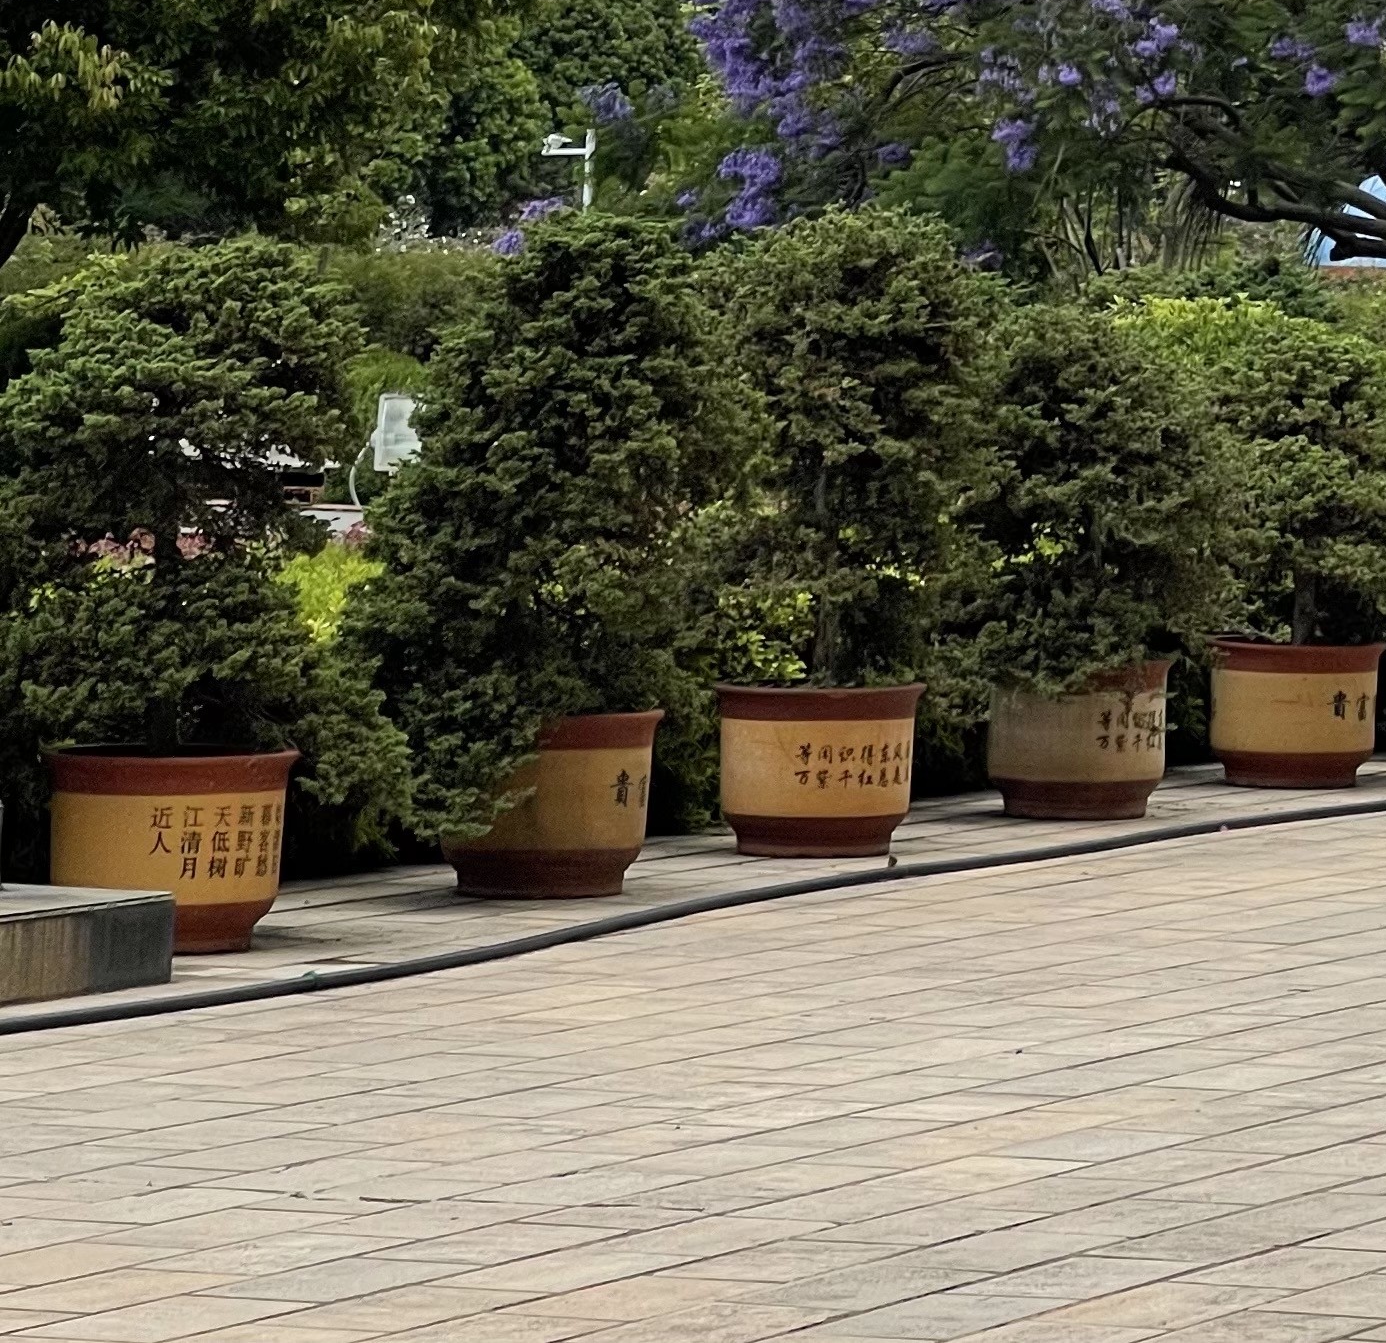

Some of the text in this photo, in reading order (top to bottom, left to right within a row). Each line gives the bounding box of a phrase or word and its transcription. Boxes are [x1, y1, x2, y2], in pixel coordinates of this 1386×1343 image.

[149, 806, 174, 856] 近人
[179, 805, 204, 880] 江清月
